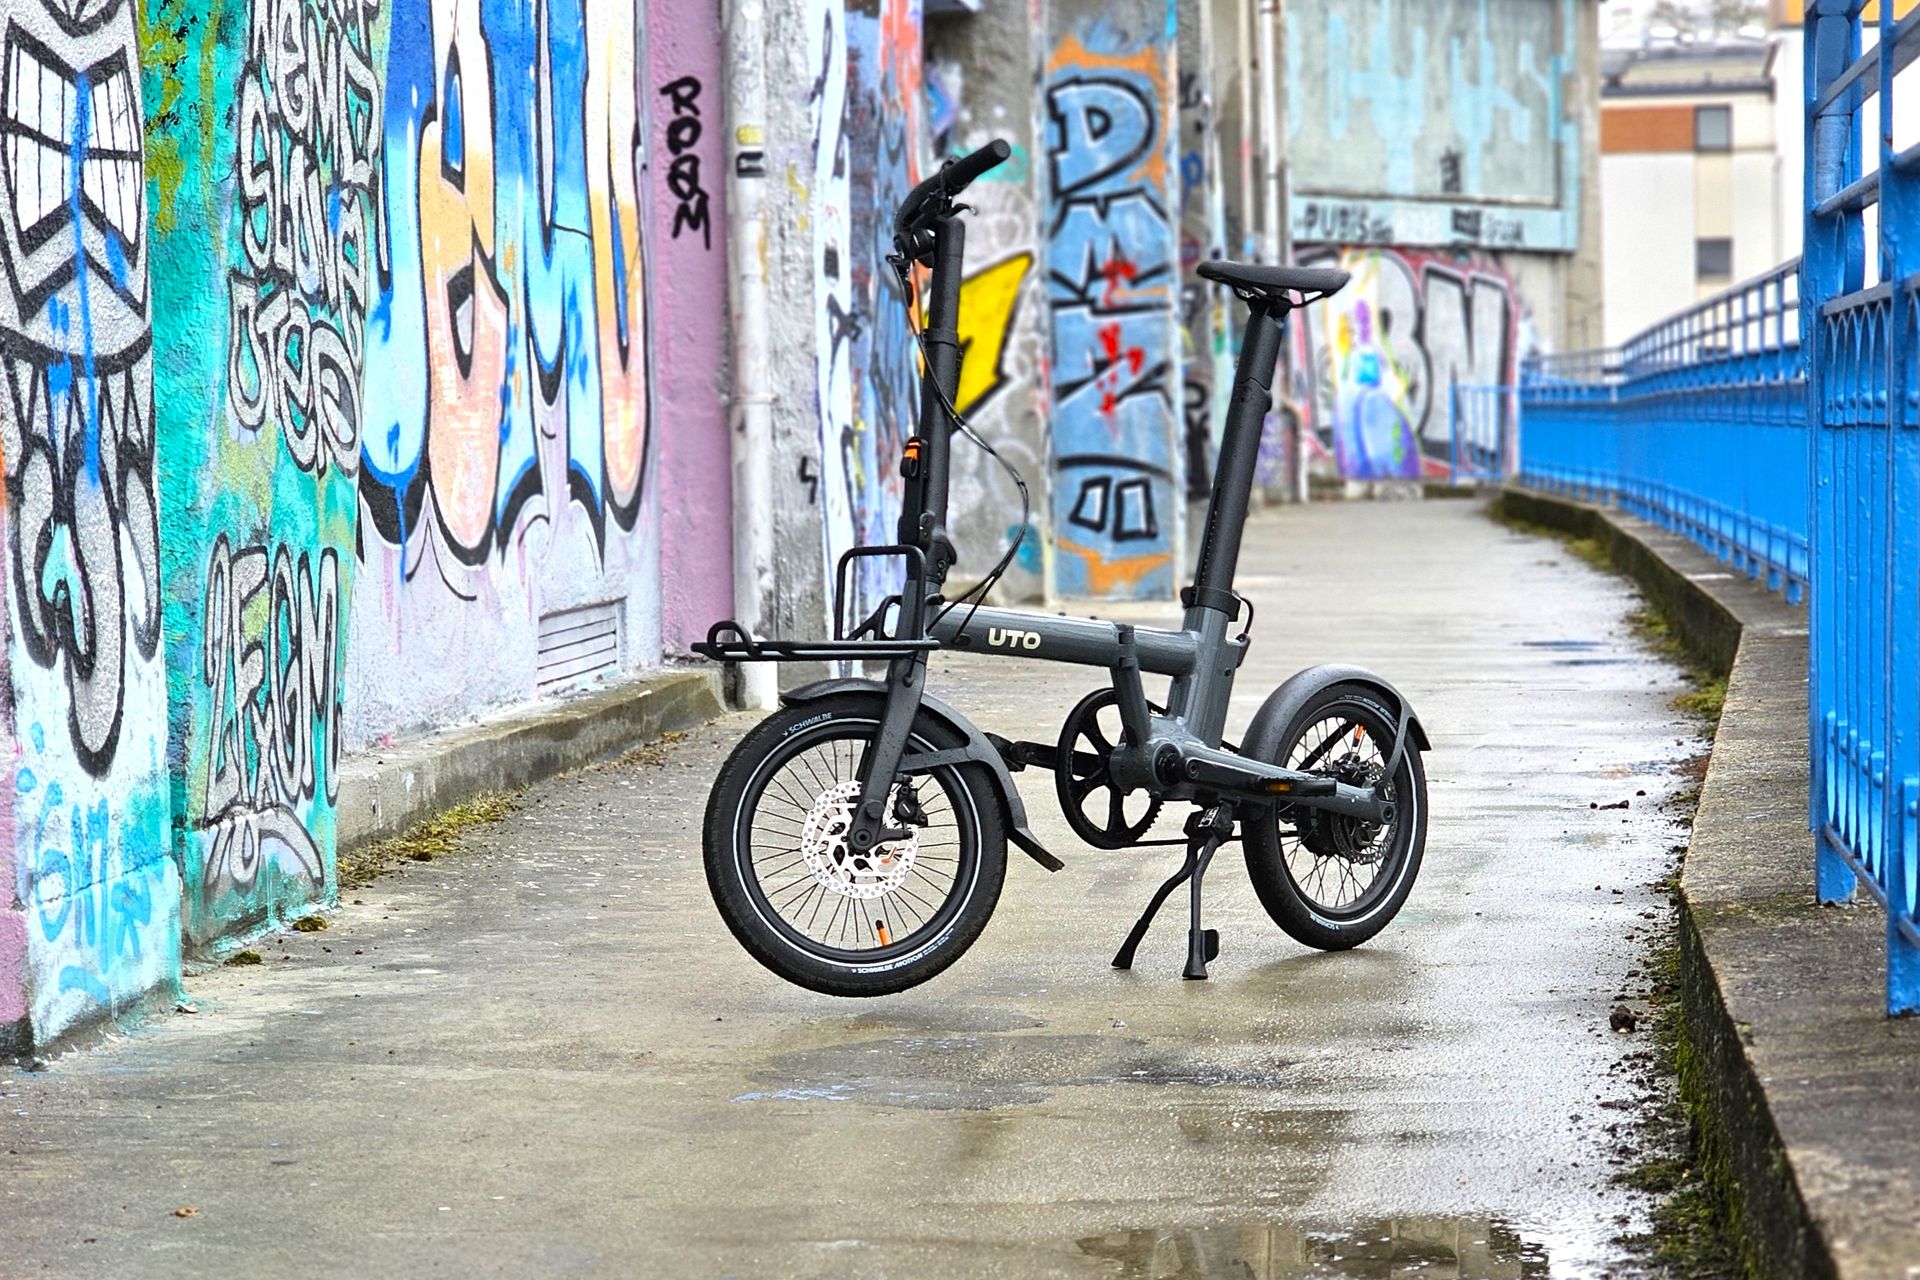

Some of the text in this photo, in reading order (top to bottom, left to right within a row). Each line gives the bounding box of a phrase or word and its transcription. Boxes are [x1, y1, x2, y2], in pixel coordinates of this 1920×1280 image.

[988, 627, 1041, 650] UTO
[788, 711, 833, 734] SCHWALBE
[894, 952, 923, 969] MOTION
